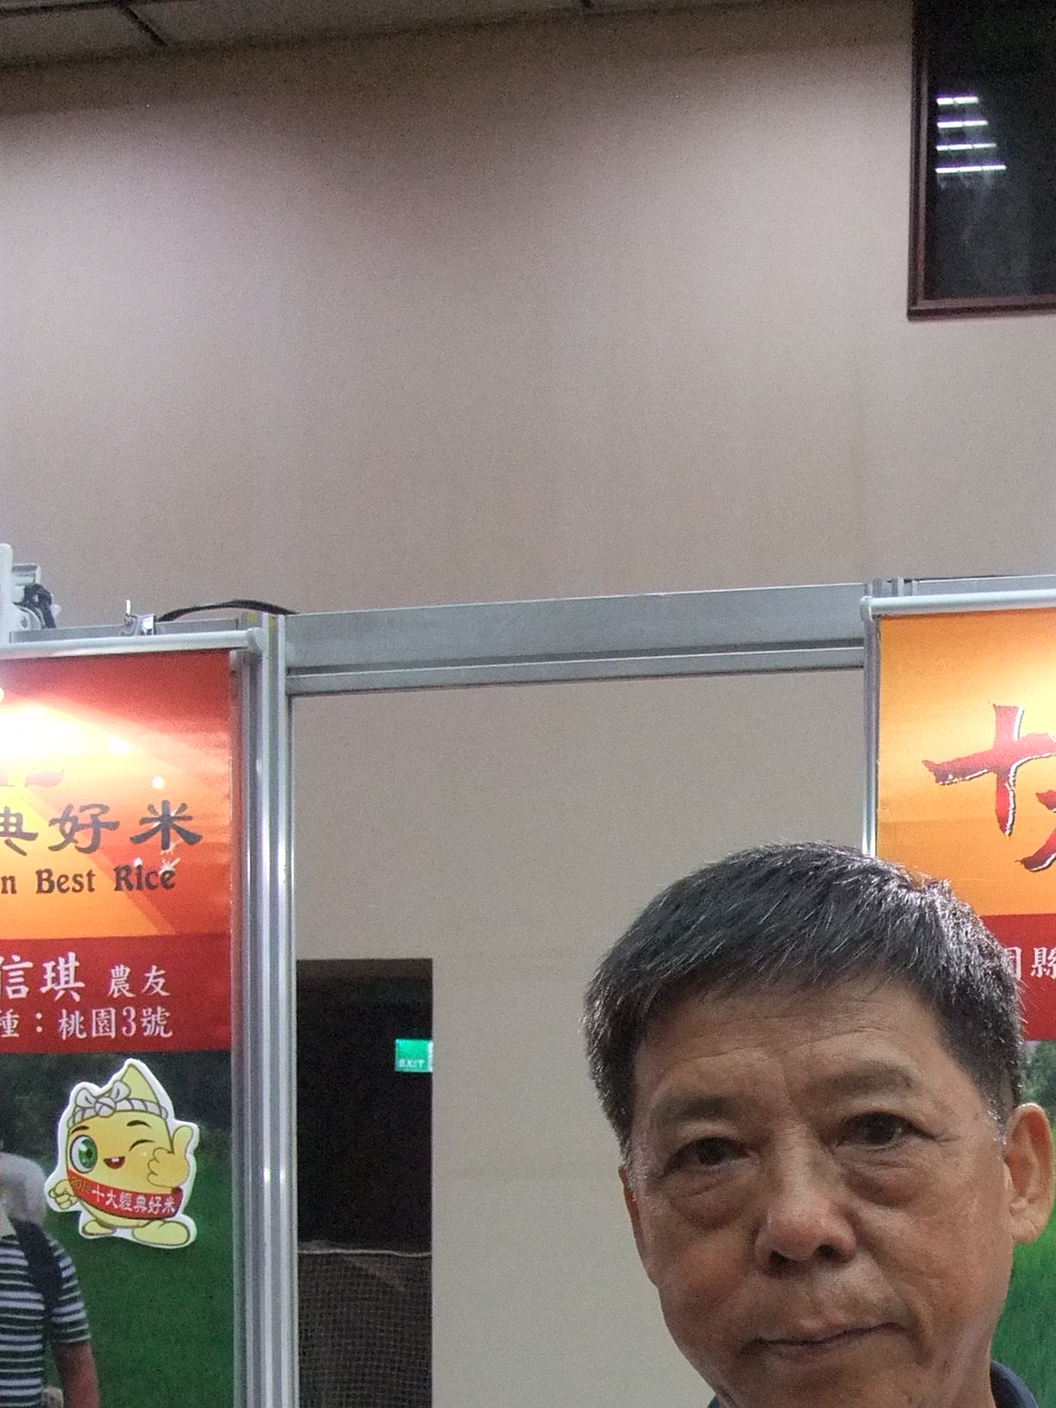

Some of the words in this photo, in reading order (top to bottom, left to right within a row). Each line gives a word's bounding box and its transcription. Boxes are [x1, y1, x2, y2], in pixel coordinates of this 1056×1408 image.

[35, 866, 96, 895] Best
[113, 862, 176, 891] Rice
[0, 951, 86, 1003] 信琪
[107, 963, 171, 999] 農友
[92, 1185, 175, 1213] 十大經典好米
